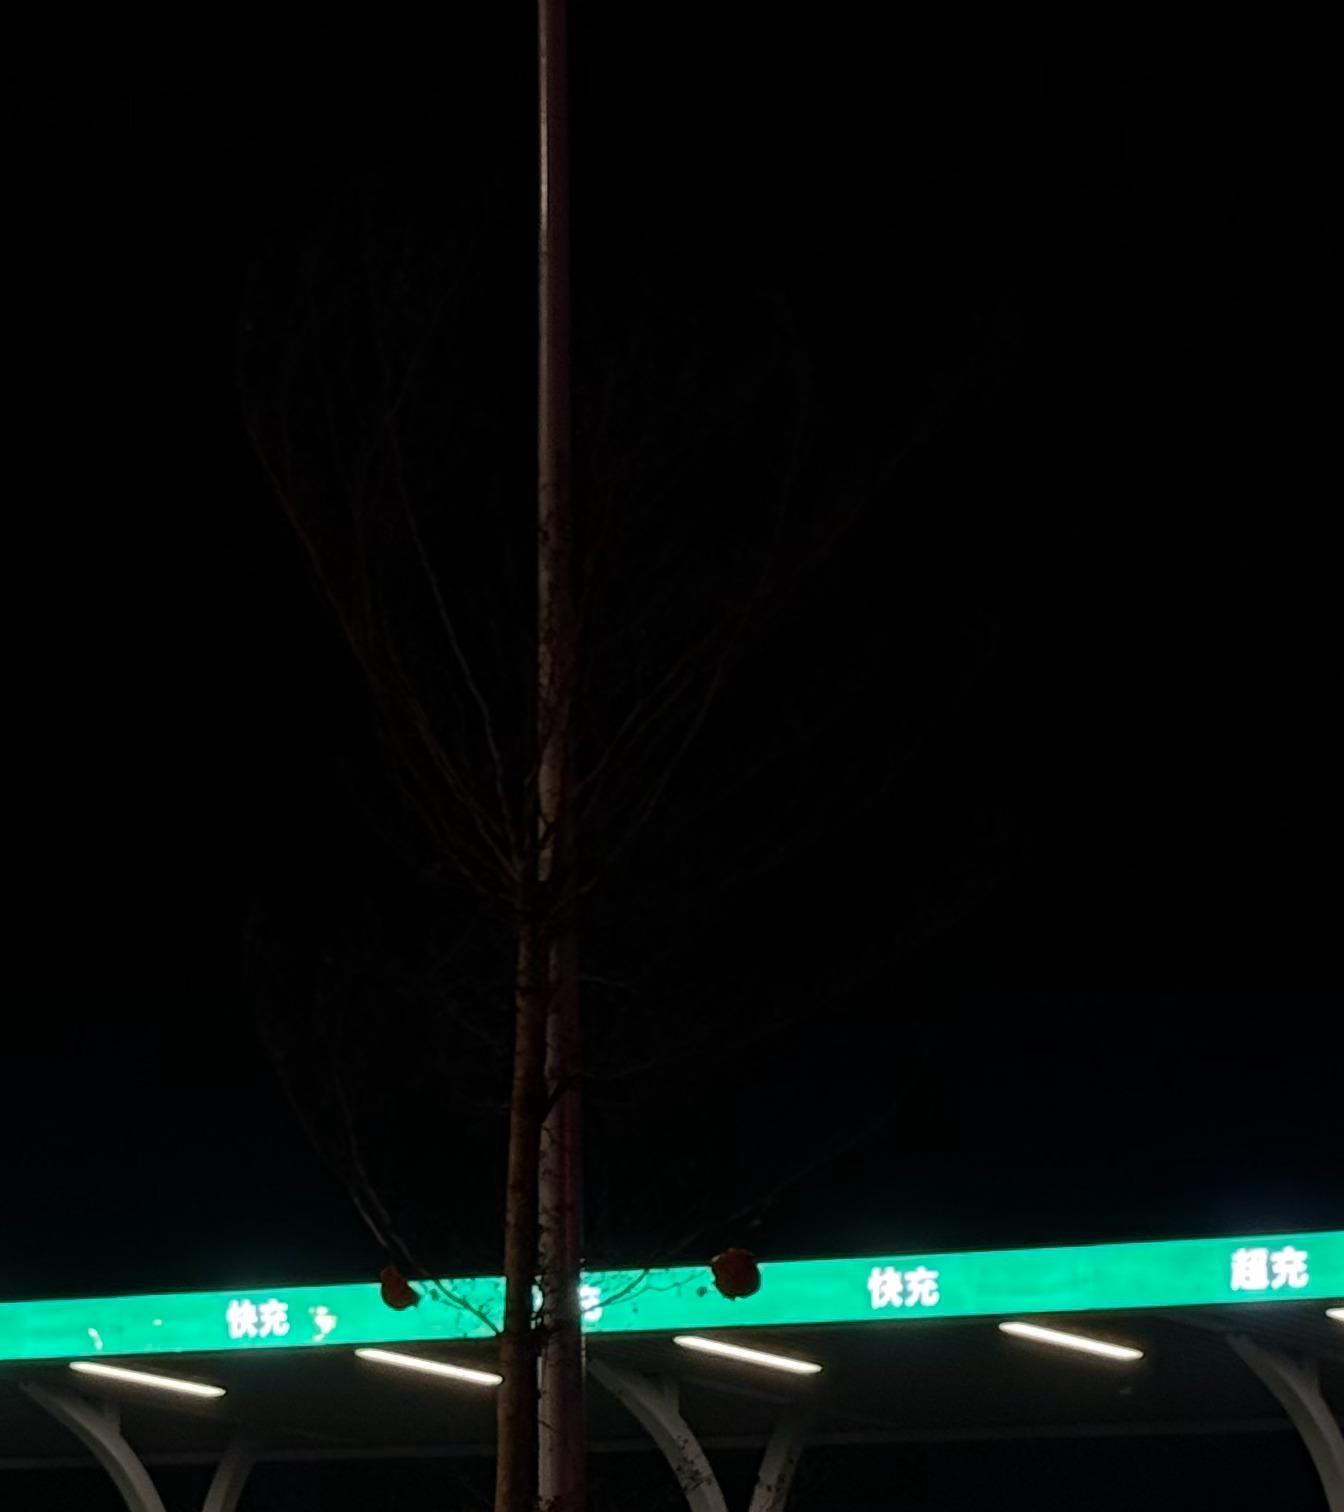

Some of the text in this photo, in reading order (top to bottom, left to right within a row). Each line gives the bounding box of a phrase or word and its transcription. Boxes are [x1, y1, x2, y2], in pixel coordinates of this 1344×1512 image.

[868, 1267, 939, 1308] 快充
[1231, 1246, 1309, 1290] 超充
[227, 1299, 289, 1338] 快充
